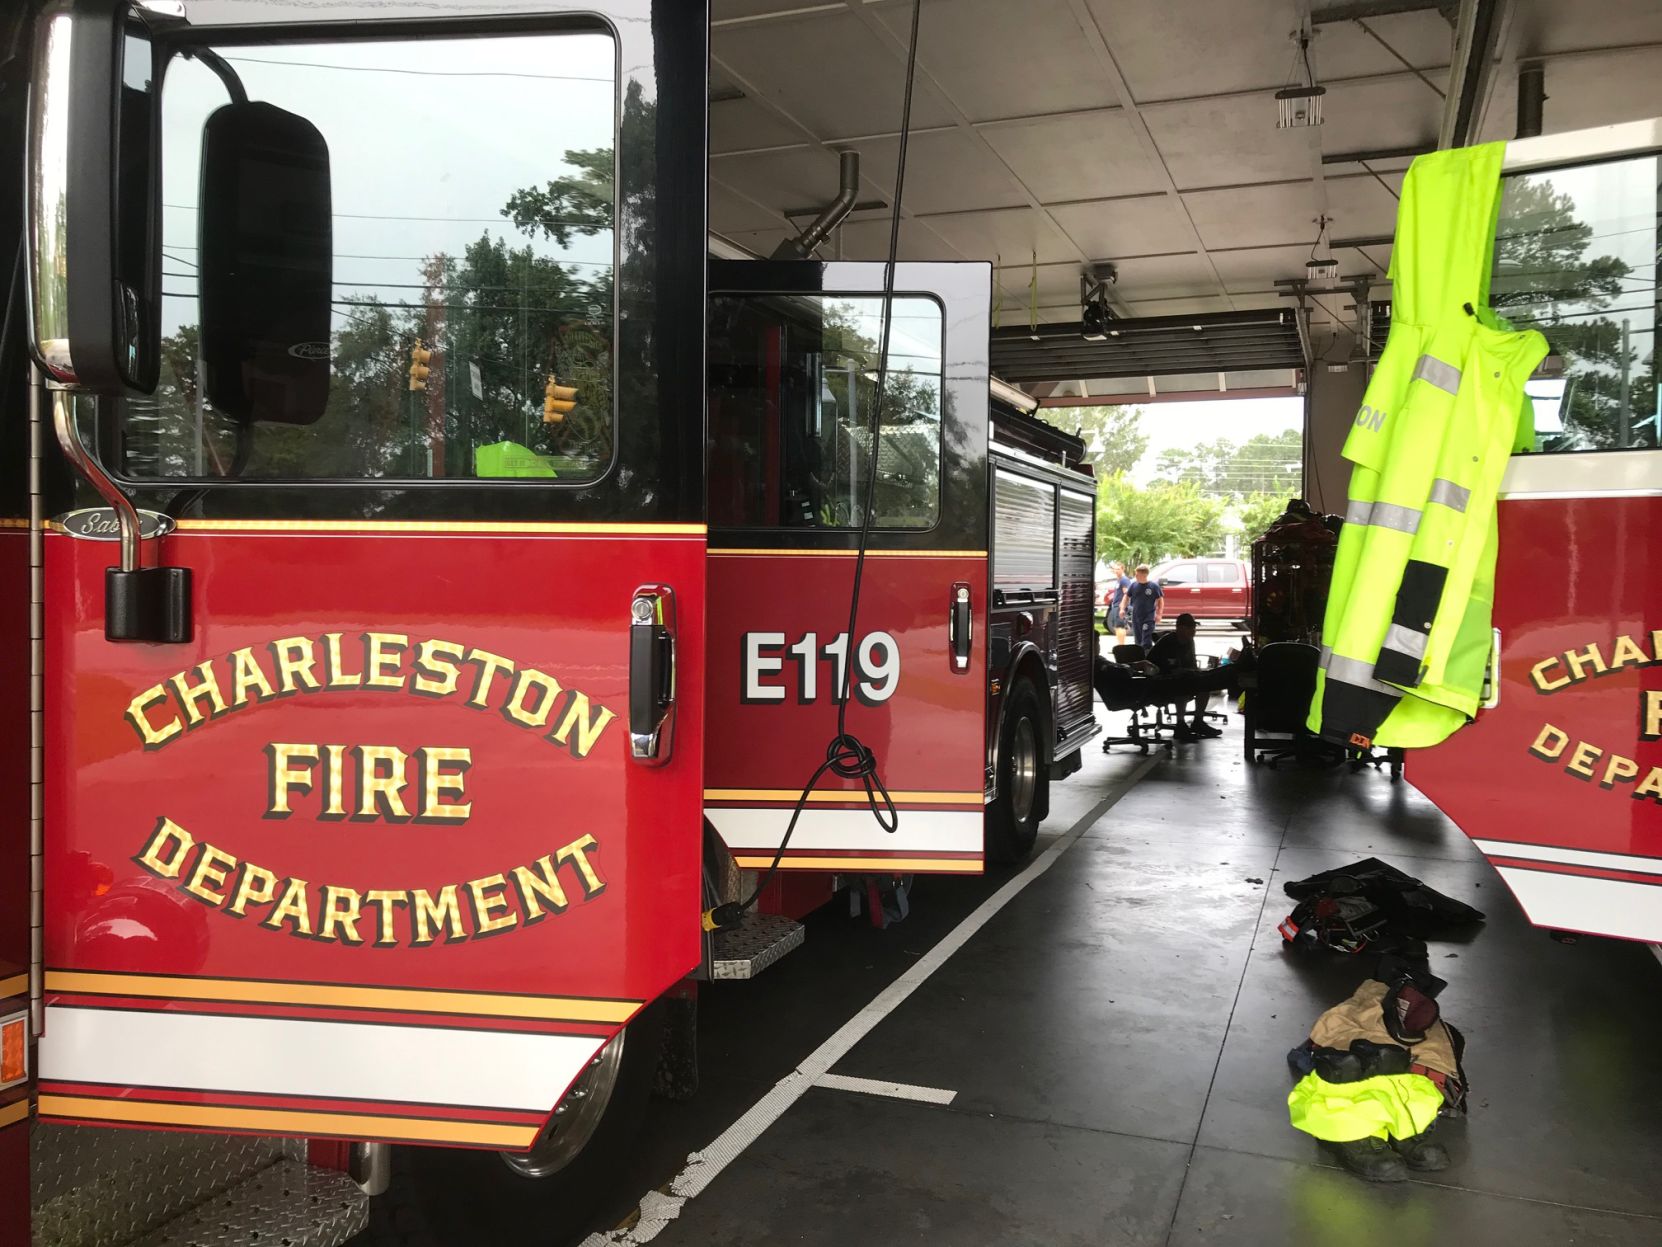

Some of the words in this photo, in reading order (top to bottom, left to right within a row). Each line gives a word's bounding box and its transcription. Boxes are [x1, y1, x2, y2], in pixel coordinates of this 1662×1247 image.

[80, 512, 142, 534] Sab
[124, 632, 618, 758] CHARLESTON
[740, 631, 900, 706] E119
[1529, 630, 1662, 694] CHA
[264, 743, 472, 824] FIRE
[132, 816, 607, 947] DEPARTMENT
